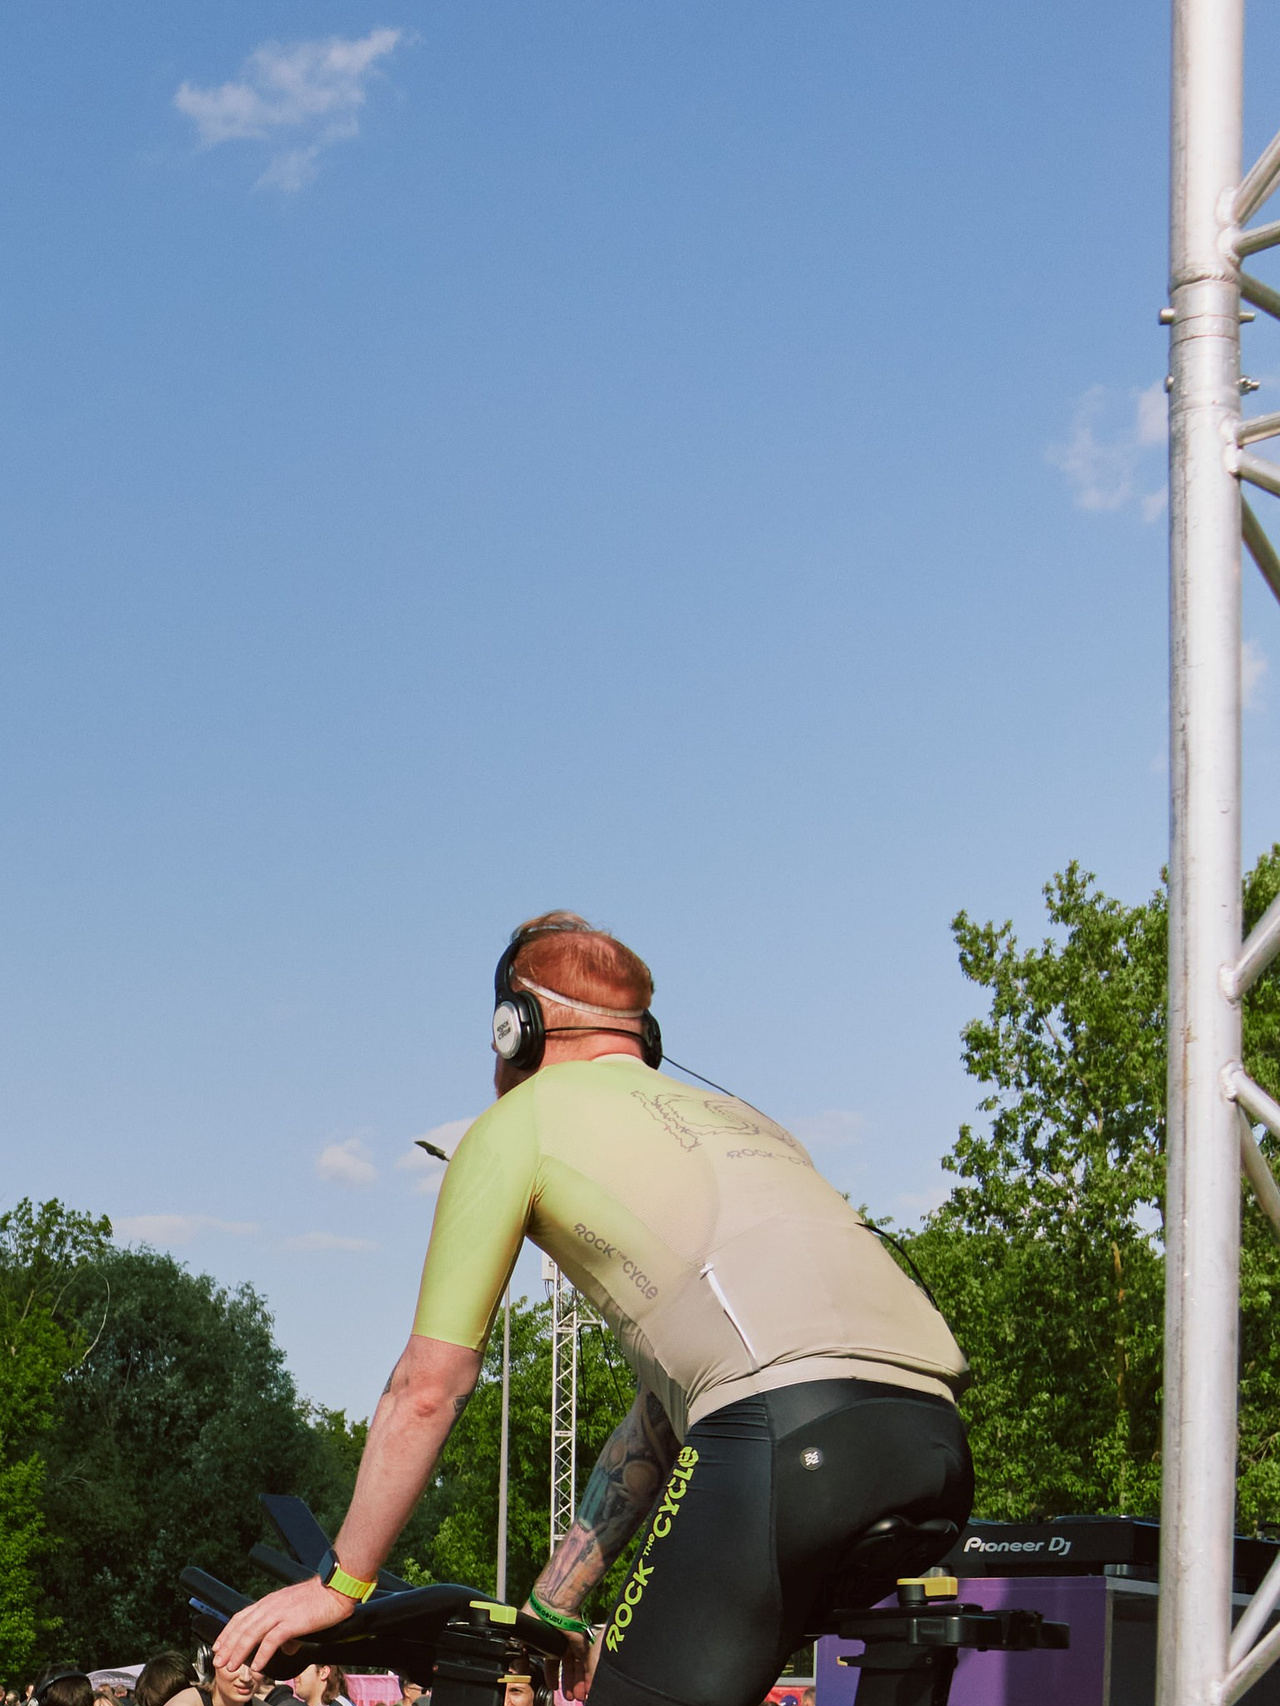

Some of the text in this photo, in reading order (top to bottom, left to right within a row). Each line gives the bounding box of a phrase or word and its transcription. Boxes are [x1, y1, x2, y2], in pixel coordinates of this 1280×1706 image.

[574, 1223, 617, 1259] ROCK
[963, 1536, 1044, 1553] Pioneer
[606, 1558, 655, 1653] ROCK
